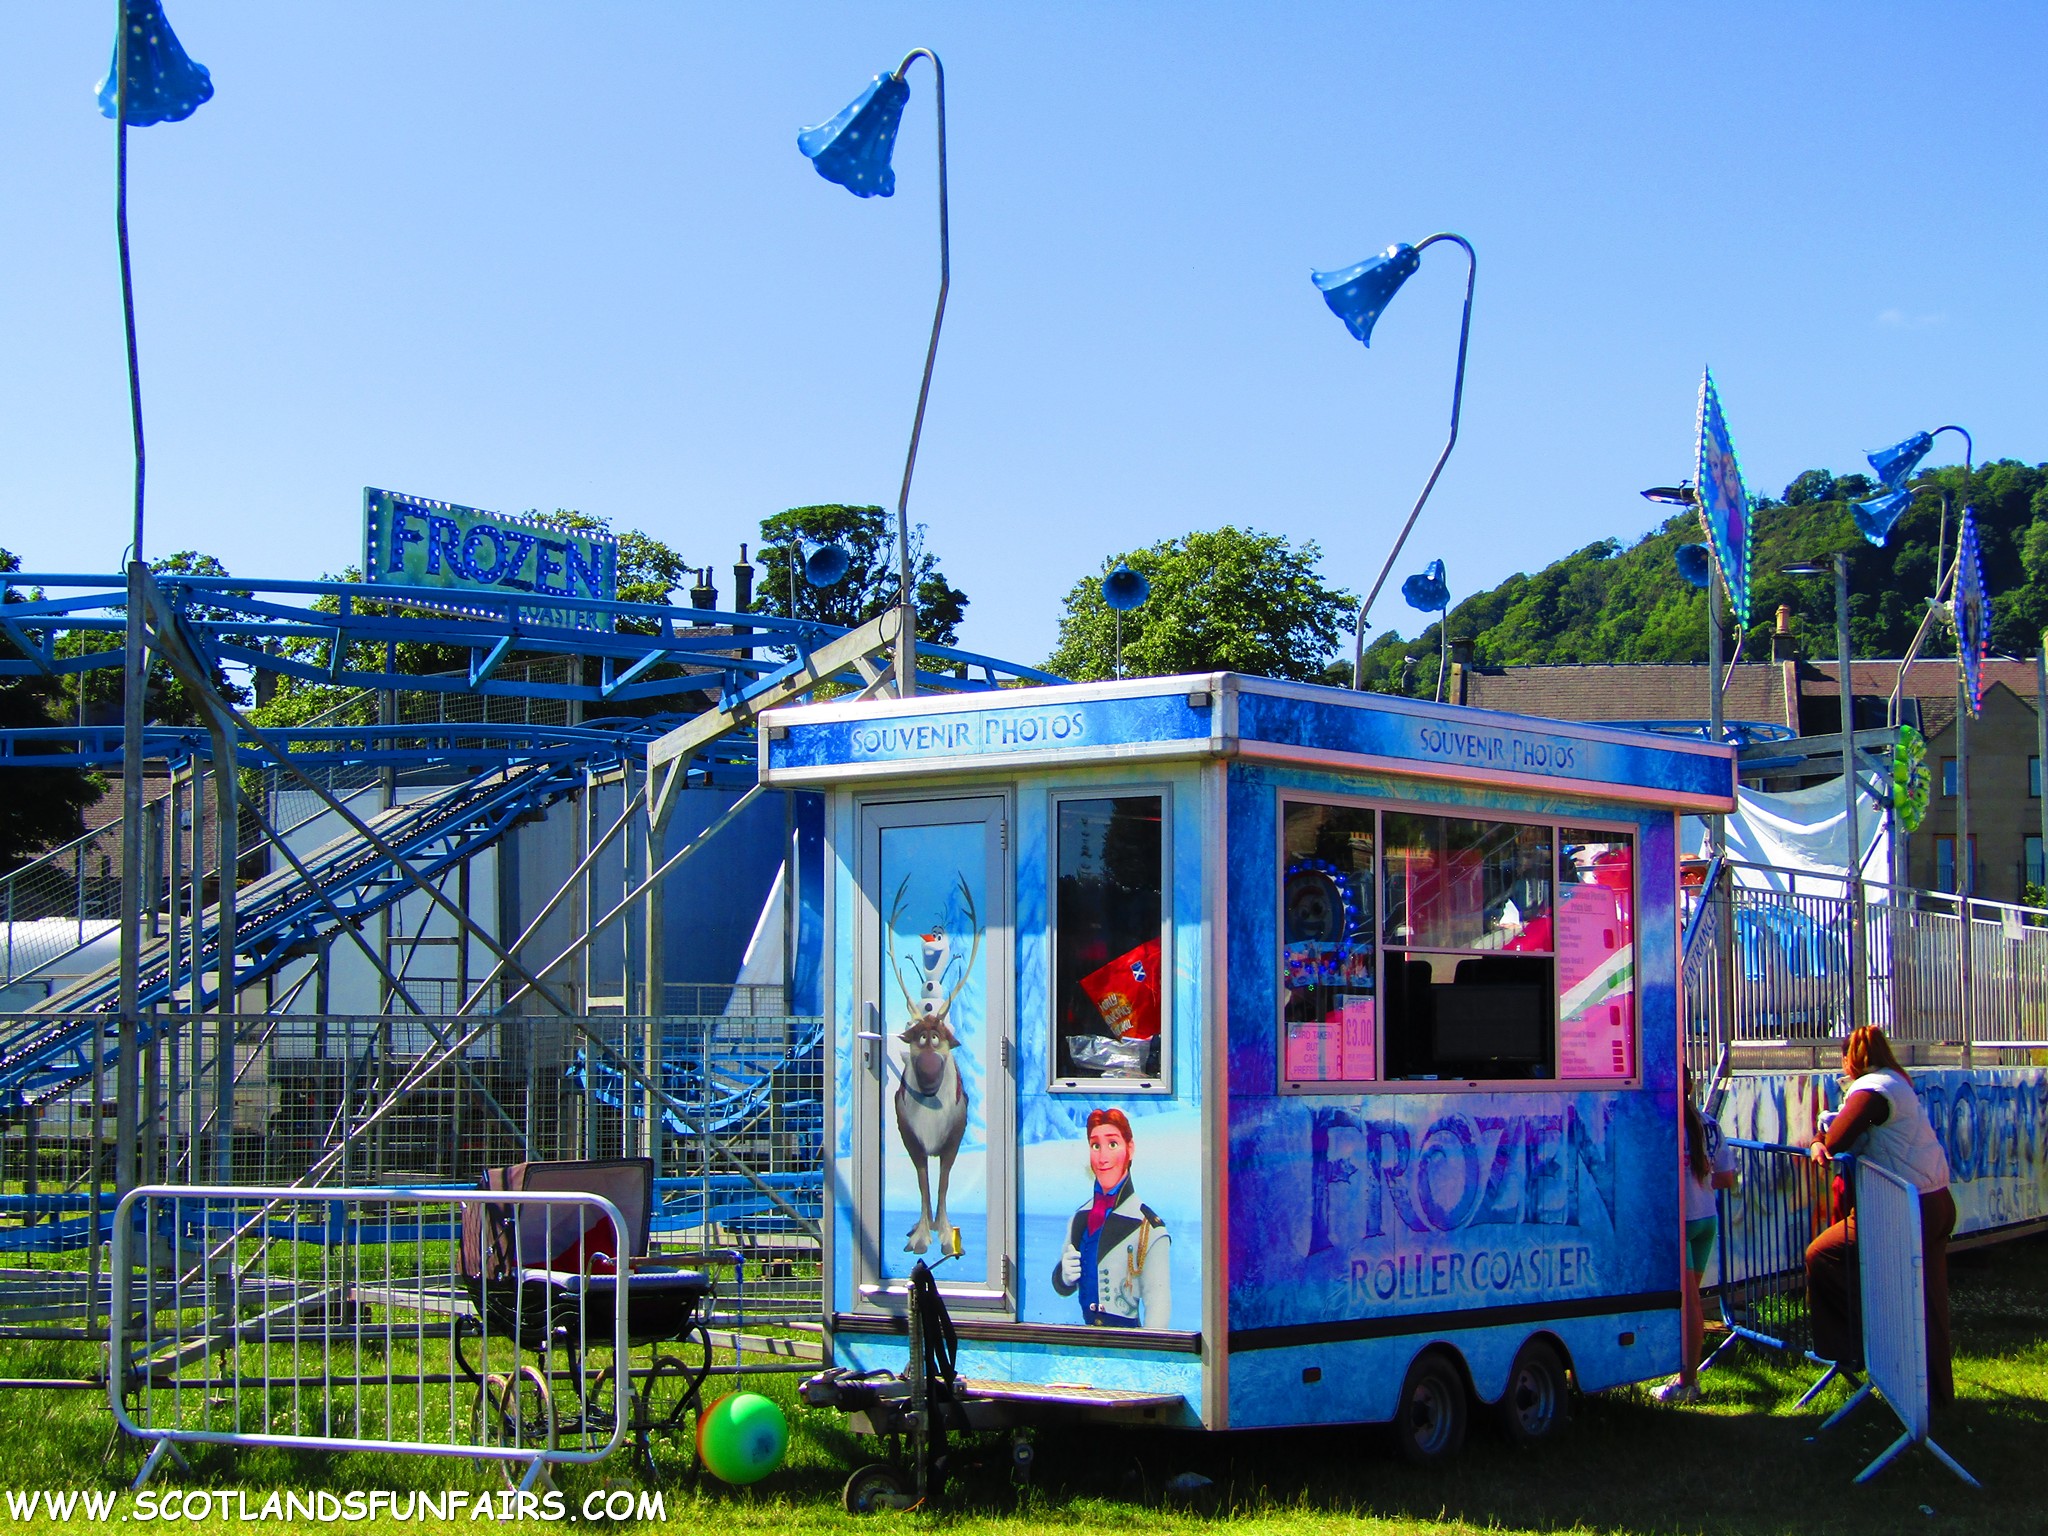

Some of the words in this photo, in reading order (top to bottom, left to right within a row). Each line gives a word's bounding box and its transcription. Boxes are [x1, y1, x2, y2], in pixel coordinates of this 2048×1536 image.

[387, 501, 604, 599] FROZEN
[852, 723, 970, 754] SOUVENIR
[985, 713, 1085, 745] PHOTOS
[1420, 728, 1504, 761] SOUVENIR
[1512, 740, 1575, 769] PHOTOS
[1684, 907, 1717, 989] ENTRANCE
[1305, 1042, 1320, 1052] BUT
[1346, 1018, 1373, 1047] £3.00
[1912, 1076, 2038, 1183] ROZEN
[1306, 1102, 1616, 1257] FROZEN
[1989, 1183, 2042, 1222] COASTER
